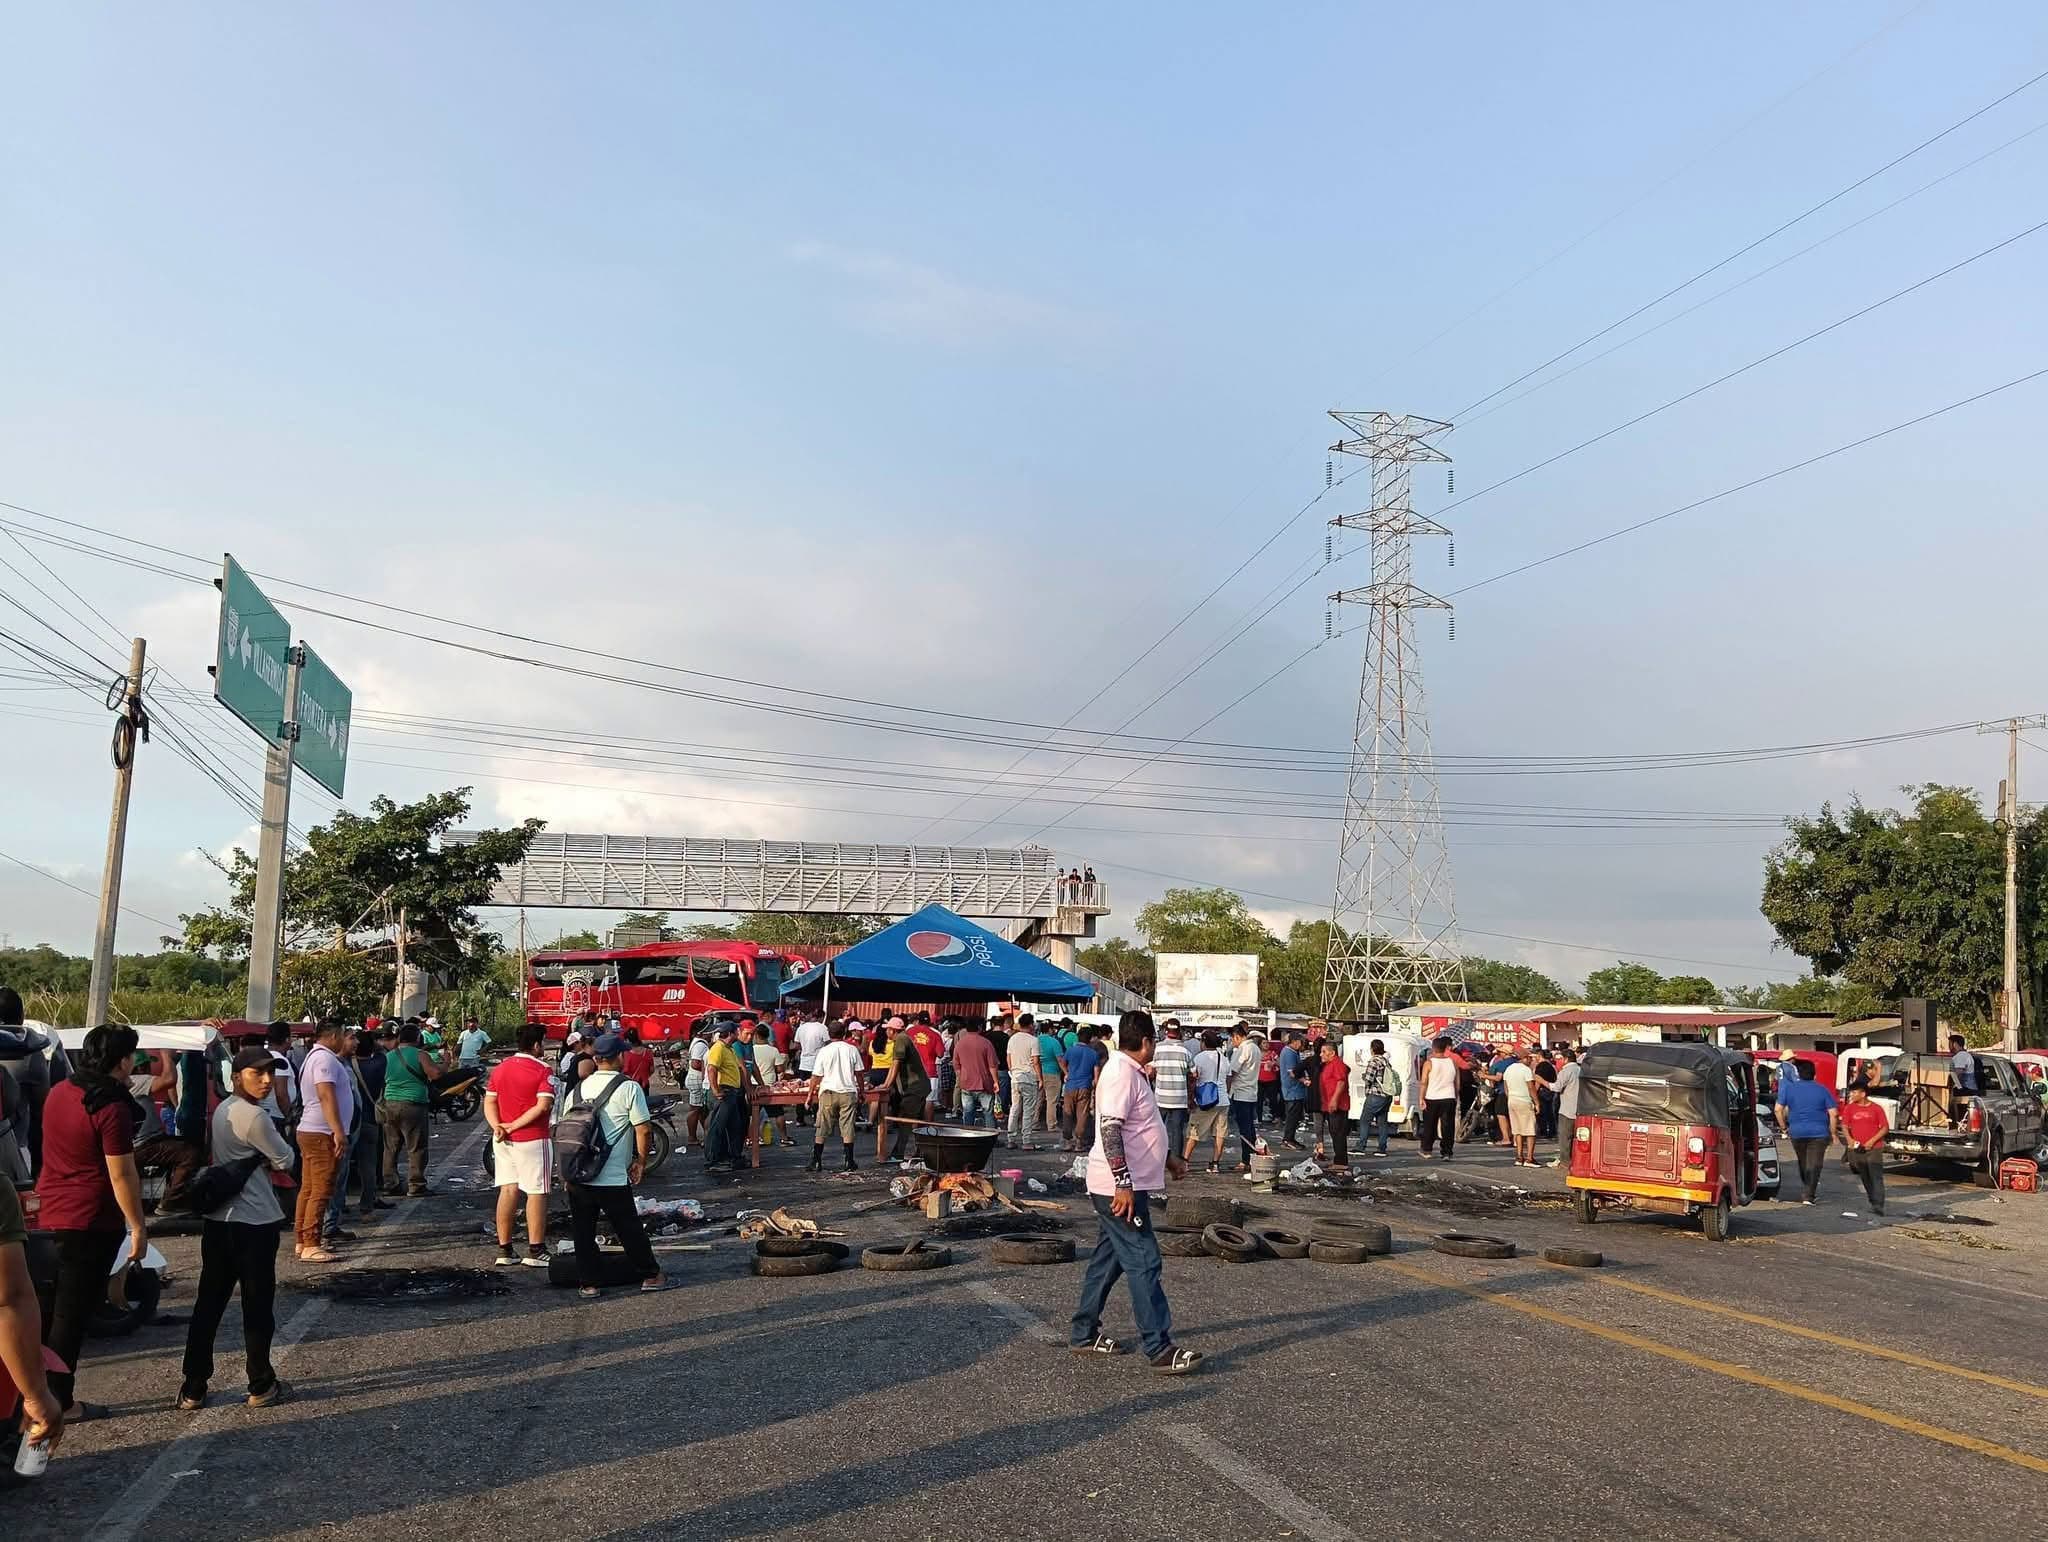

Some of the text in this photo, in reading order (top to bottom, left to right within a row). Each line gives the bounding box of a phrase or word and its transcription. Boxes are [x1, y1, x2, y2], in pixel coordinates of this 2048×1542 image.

[300, 689, 328, 739] FRONTERA
[965, 935, 1000, 968] pepsi
[662, 988, 686, 1001] ADO
[1503, 1023, 1513, 1031] LA
[1488, 1030, 1518, 1042] CHEPE
